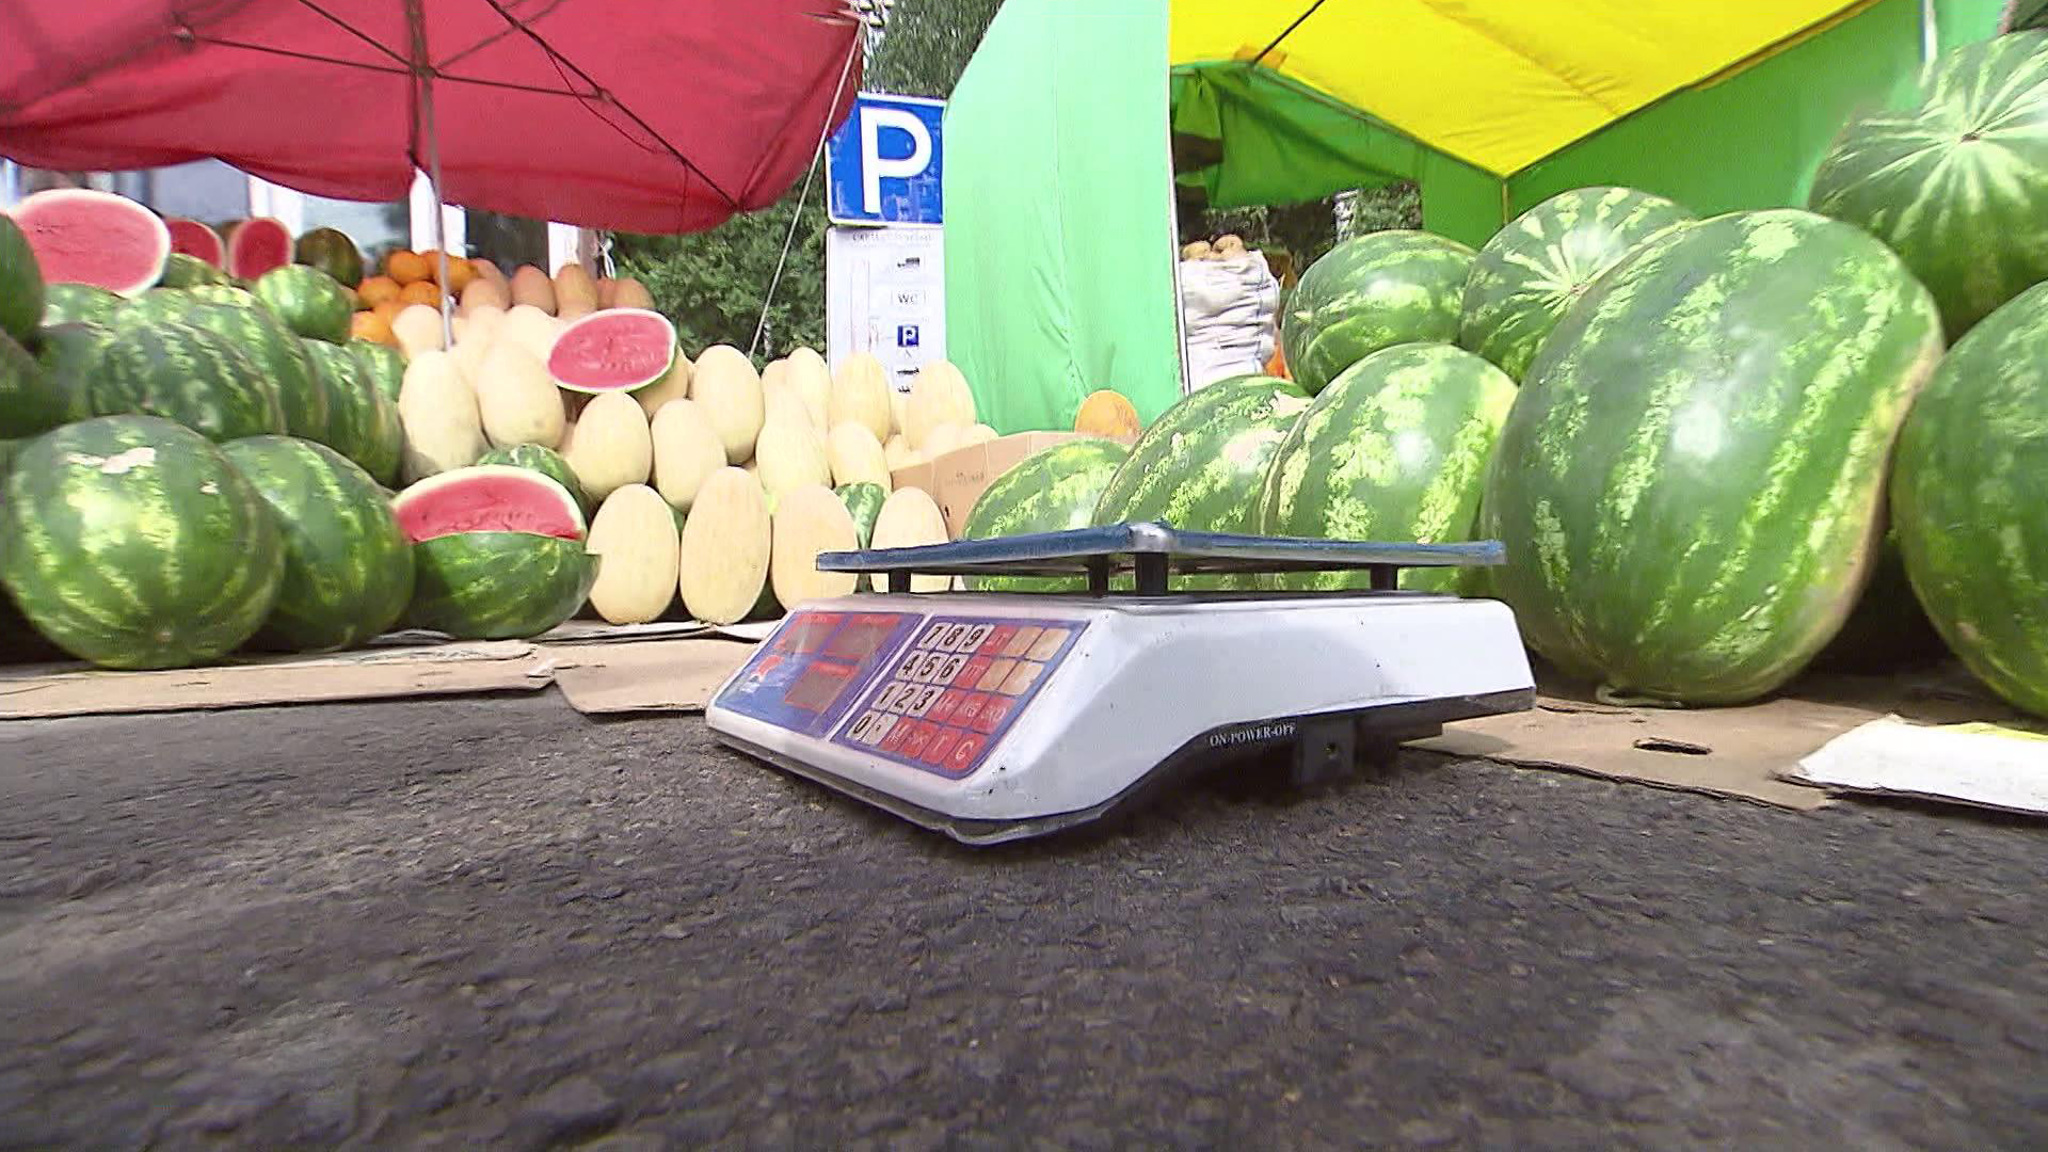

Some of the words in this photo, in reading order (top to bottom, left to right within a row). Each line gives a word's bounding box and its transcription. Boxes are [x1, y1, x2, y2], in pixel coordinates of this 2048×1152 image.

[860, 106, 932, 214] P
[898, 293, 918, 303] WC
[924, 626, 944, 644] 7
[943, 627, 965, 647] 8
[964, 628, 986, 647] 9
[902, 654, 921, 676] 4
[920, 656, 941, 677] 5
[939, 658, 960, 678] 6
[894, 688, 915, 708] 2
[913, 690, 935, 710] 3
